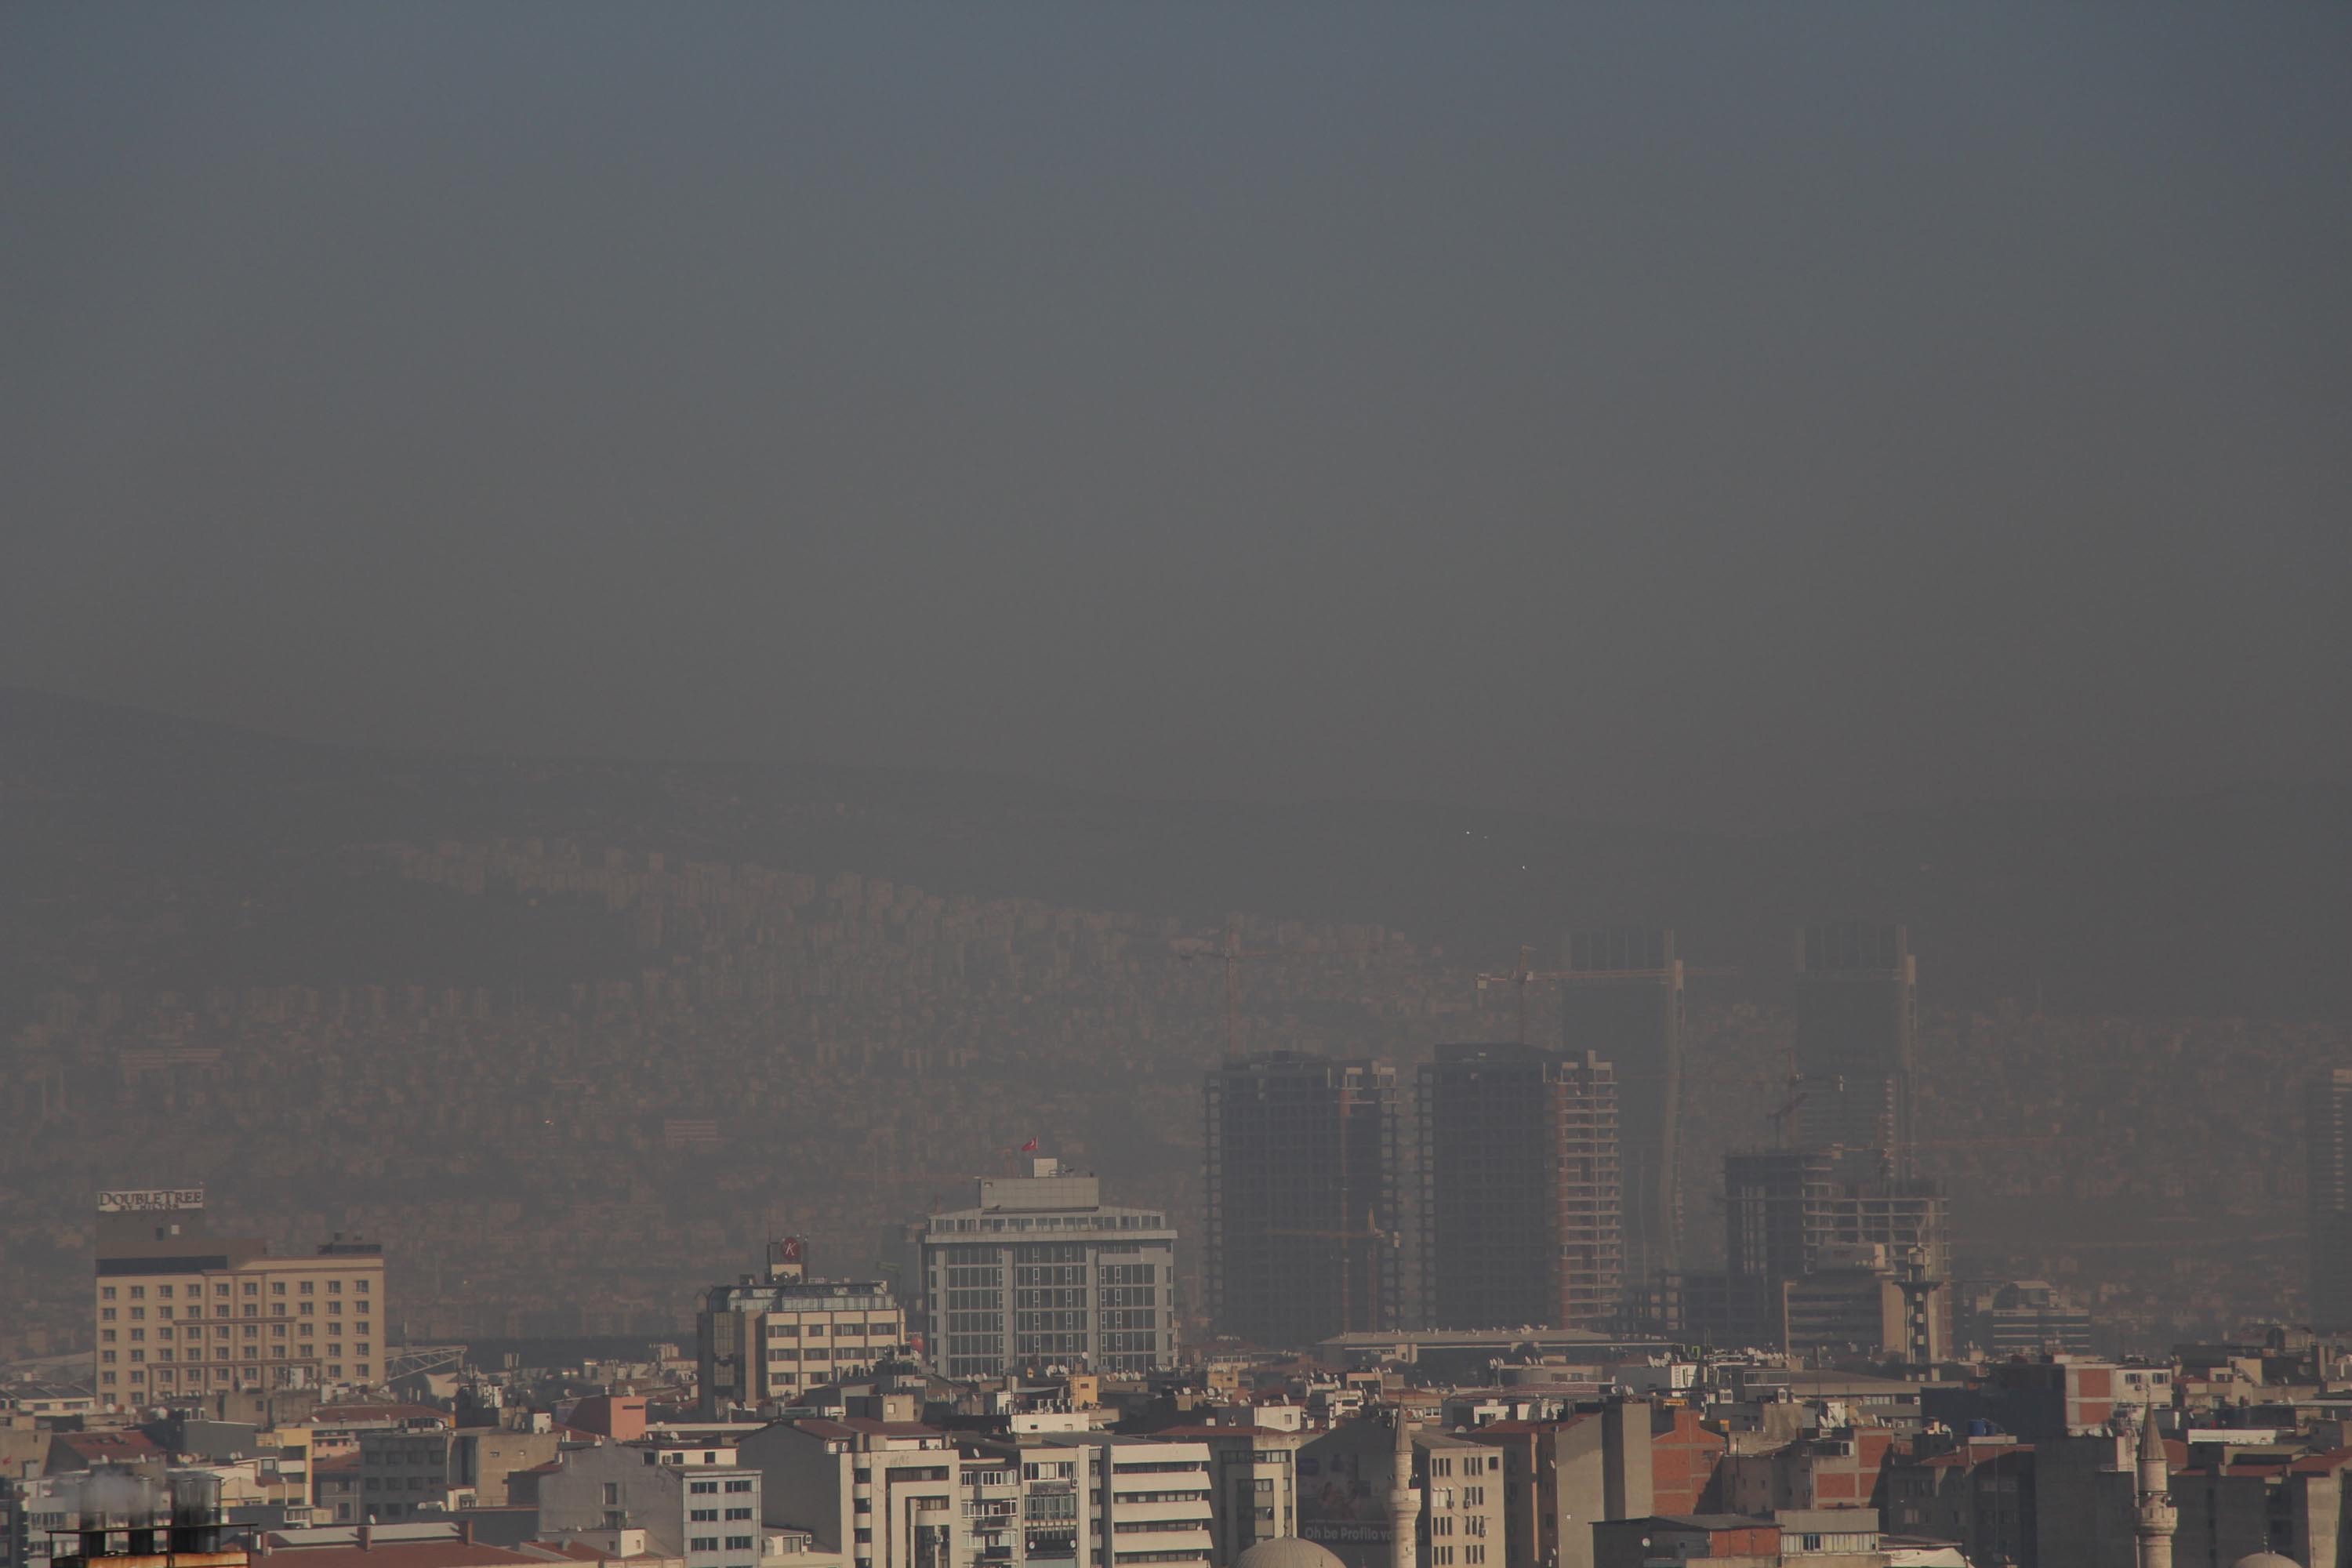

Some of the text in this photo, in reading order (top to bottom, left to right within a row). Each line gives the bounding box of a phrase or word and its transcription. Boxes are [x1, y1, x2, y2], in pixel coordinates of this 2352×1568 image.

[1305, 1525, 1321, 1539] Oh
[1323, 1525, 1338, 1539] be
[1341, 1526, 1378, 1540] Profilo
